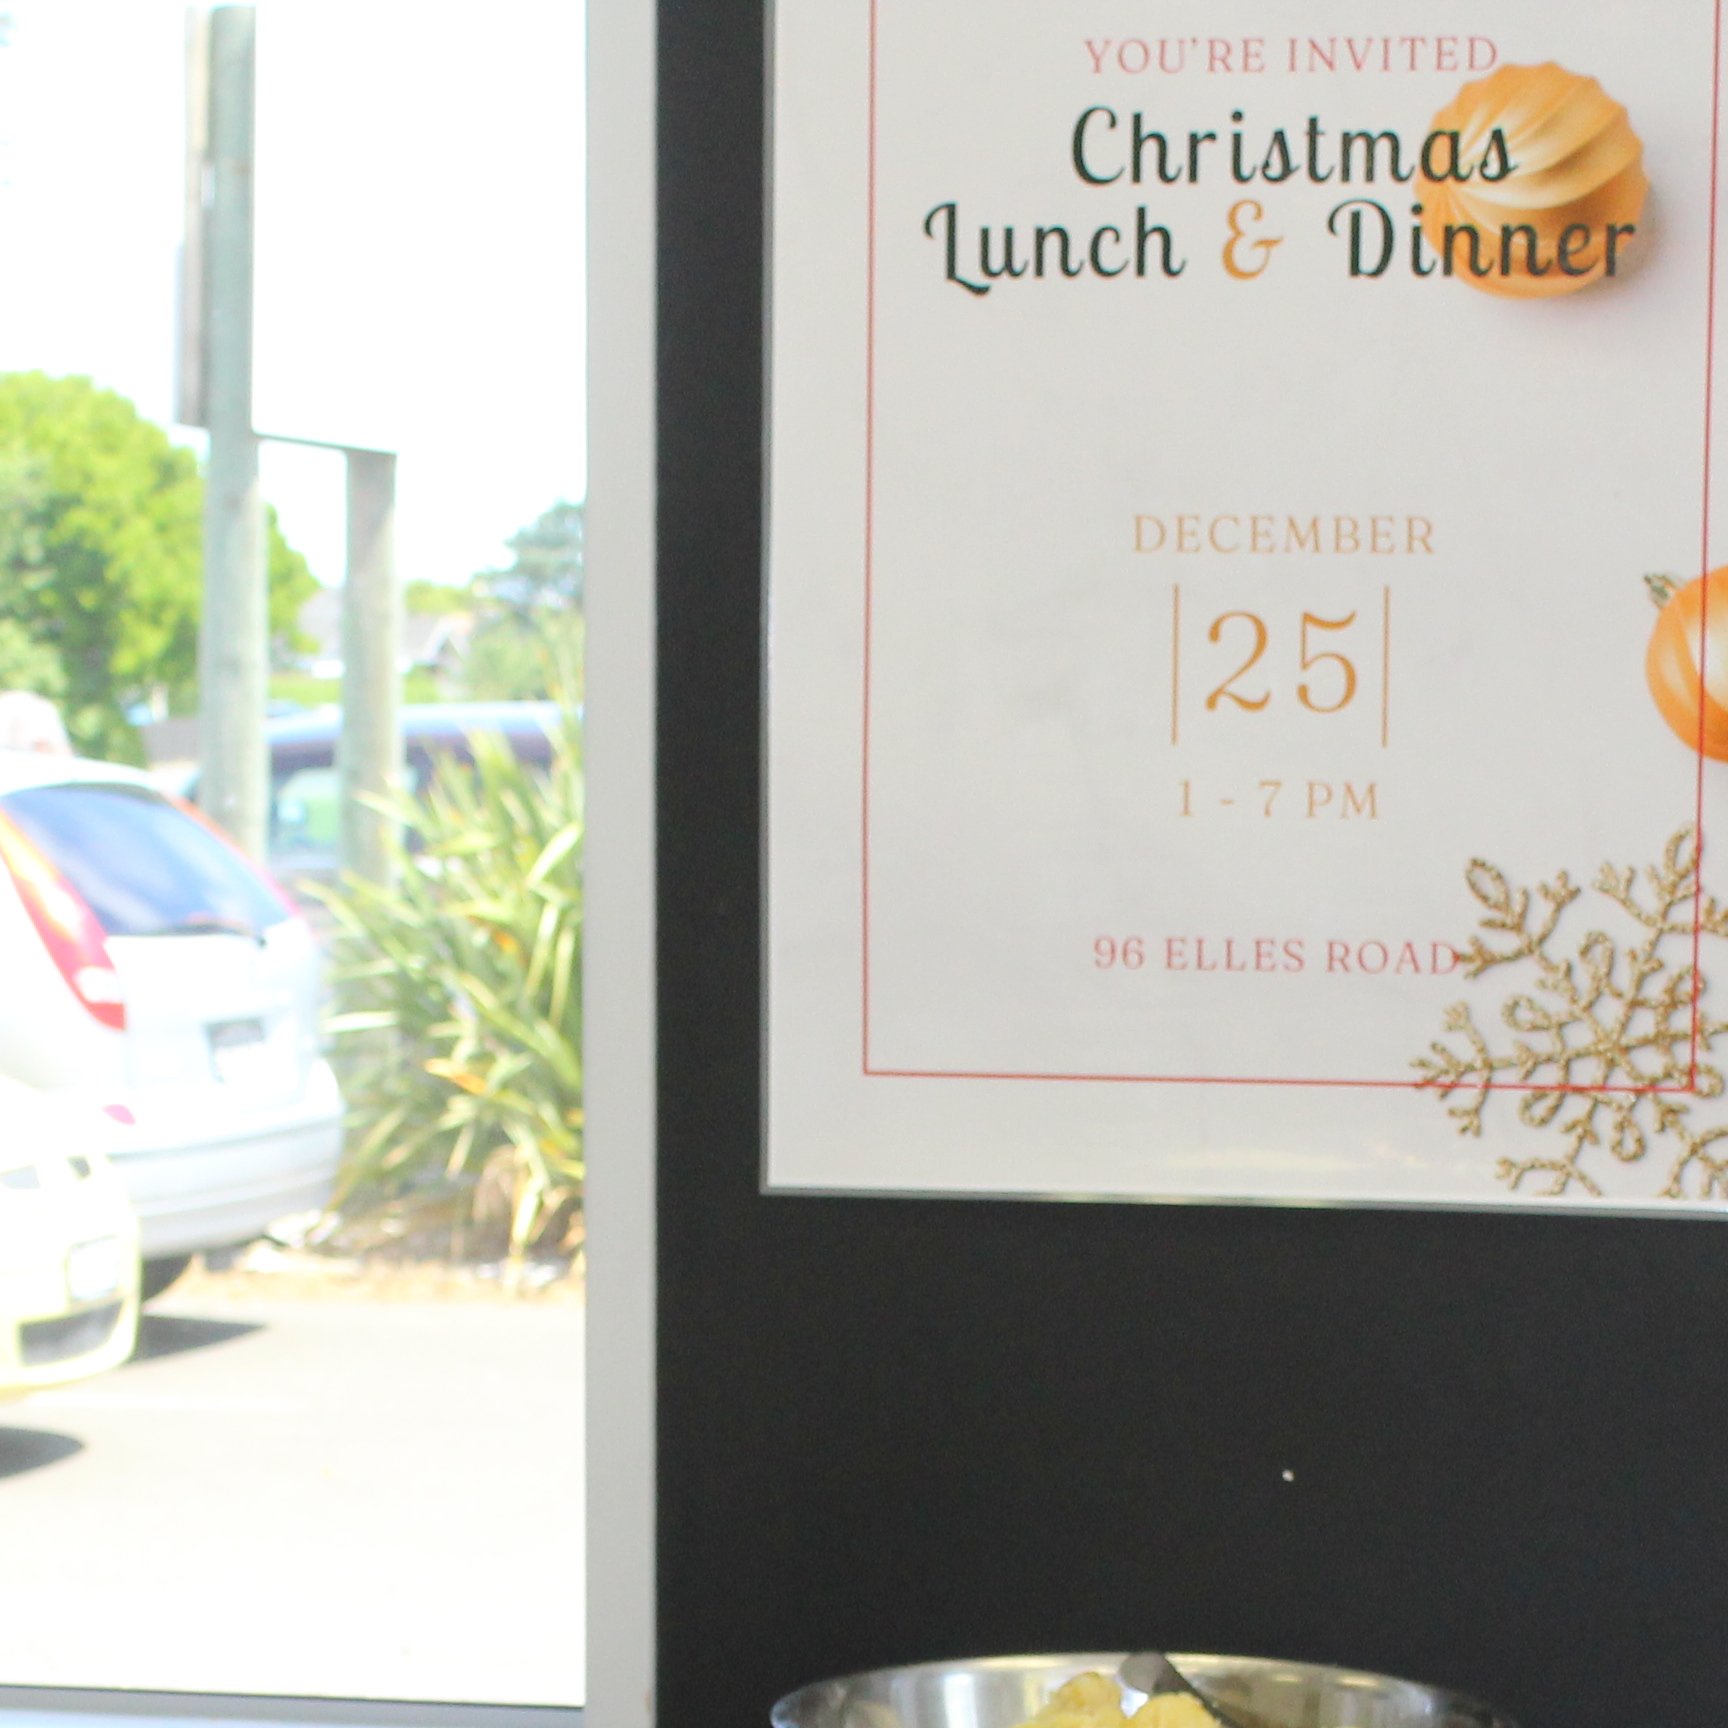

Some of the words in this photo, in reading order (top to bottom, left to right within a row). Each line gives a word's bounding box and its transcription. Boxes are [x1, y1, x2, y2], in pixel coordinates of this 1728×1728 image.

[1084, 37, 1267, 75] YOU'RE
[1288, 36, 1498, 74] INVITED
[1070, 106, 1518, 186] Christmas
[923, 201, 1188, 297] Lunch
[1221, 199, 1284, 281] &
[1327, 199, 1637, 281] Dinner
[1133, 514, 1436, 555] DECEMBER
[1205, 611, 1359, 714] 25
[1180, 781, 1195, 818] 1
[1258, 780, 1284, 819] 7
[1306, 781, 1380, 820] PM
[1093, 937, 1145, 971] 96
[1165, 937, 1307, 974] ELLES
[1325, 939, 1460, 977] ROAD
